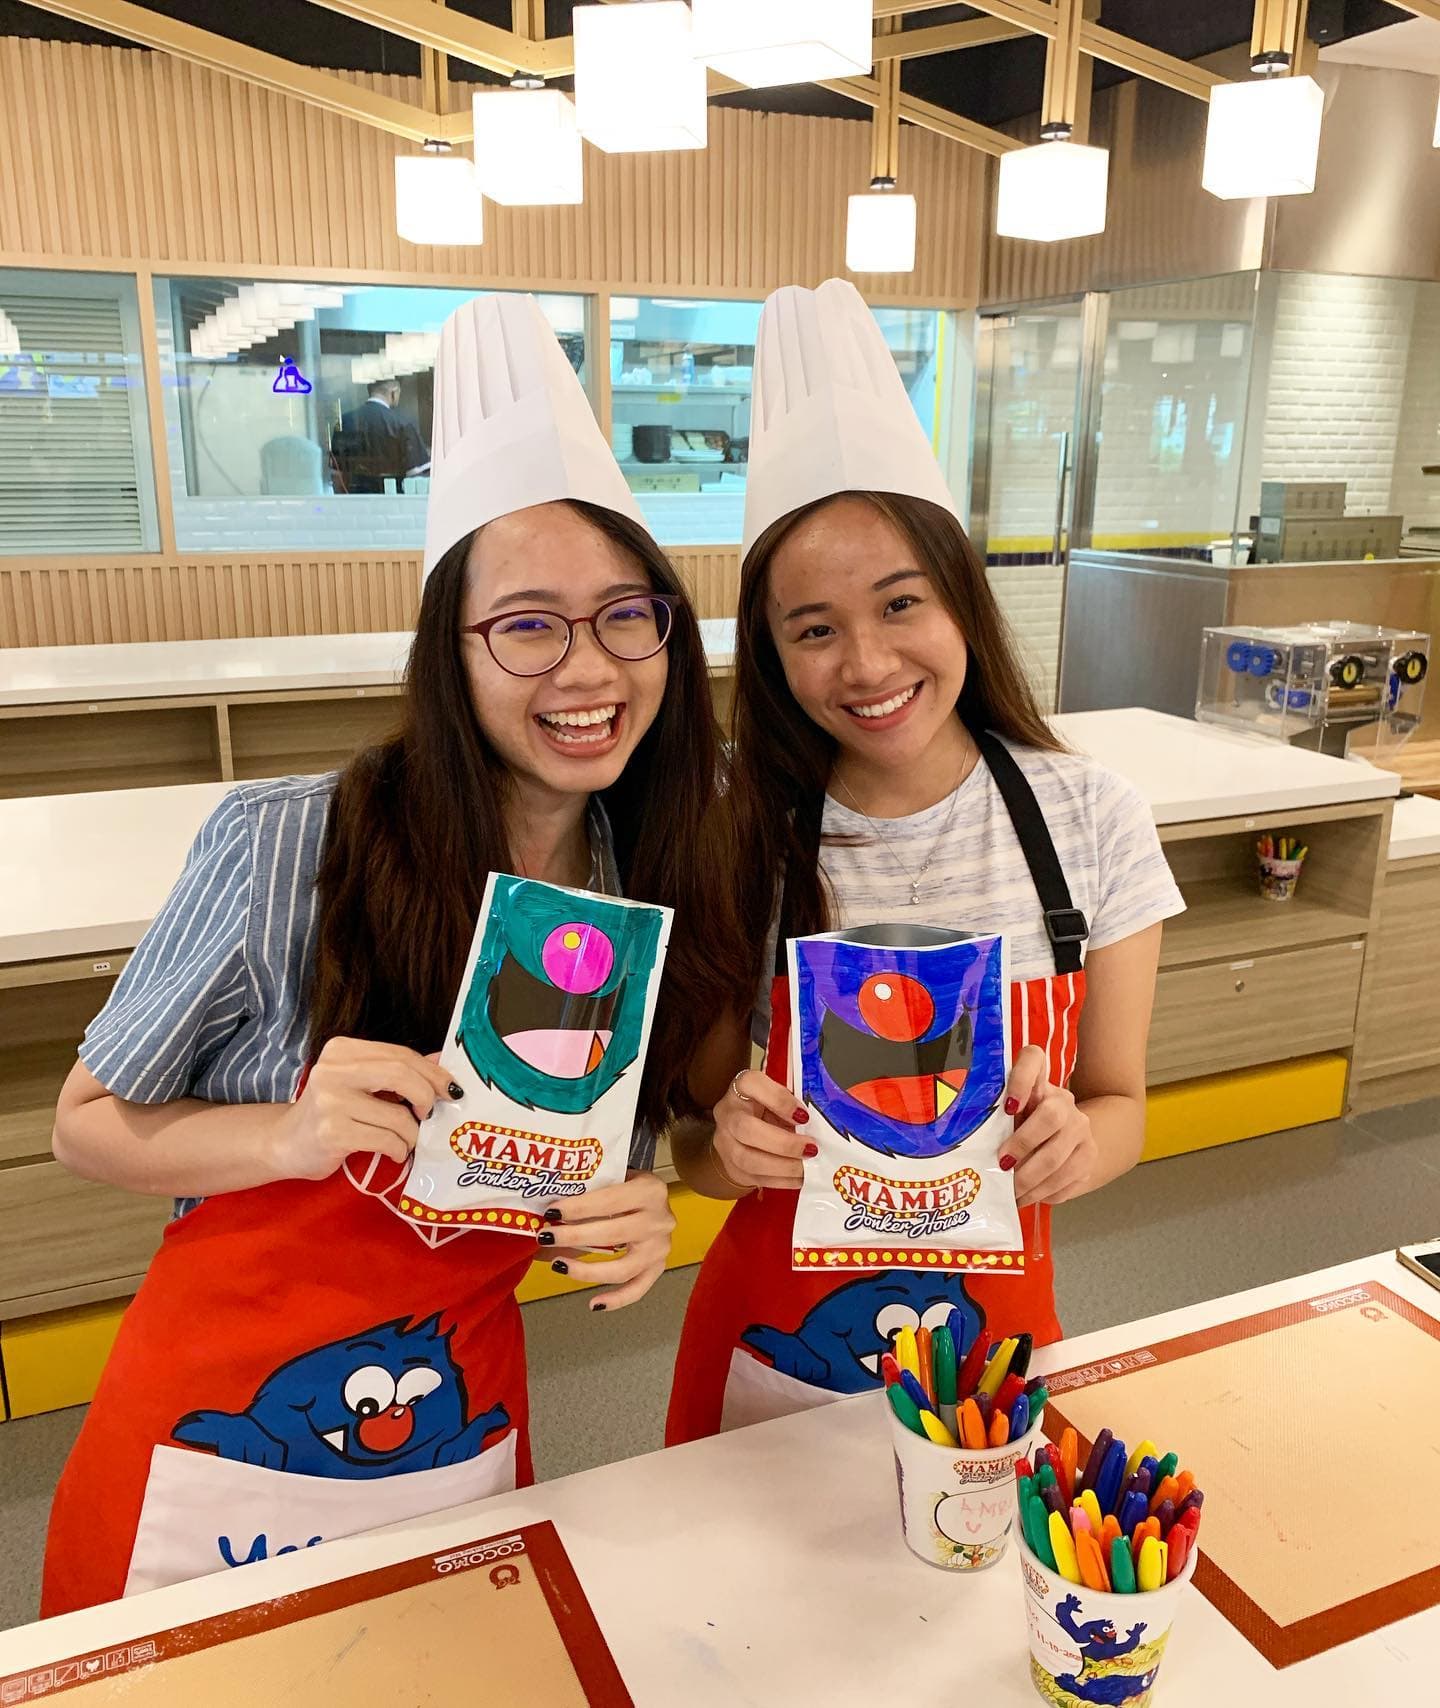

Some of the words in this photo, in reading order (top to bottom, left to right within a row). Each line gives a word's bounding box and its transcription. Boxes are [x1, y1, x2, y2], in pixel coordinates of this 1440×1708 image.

[466, 1132, 593, 1172] MAMEE
[458, 1161, 529, 1190] Jonker
[522, 1171, 587, 1197] House
[849, 1177, 968, 1211] MAMEE
[844, 1203, 912, 1233] Jonker
[908, 1209, 970, 1238] House
[437, 1541, 525, 1573] COCOMO
